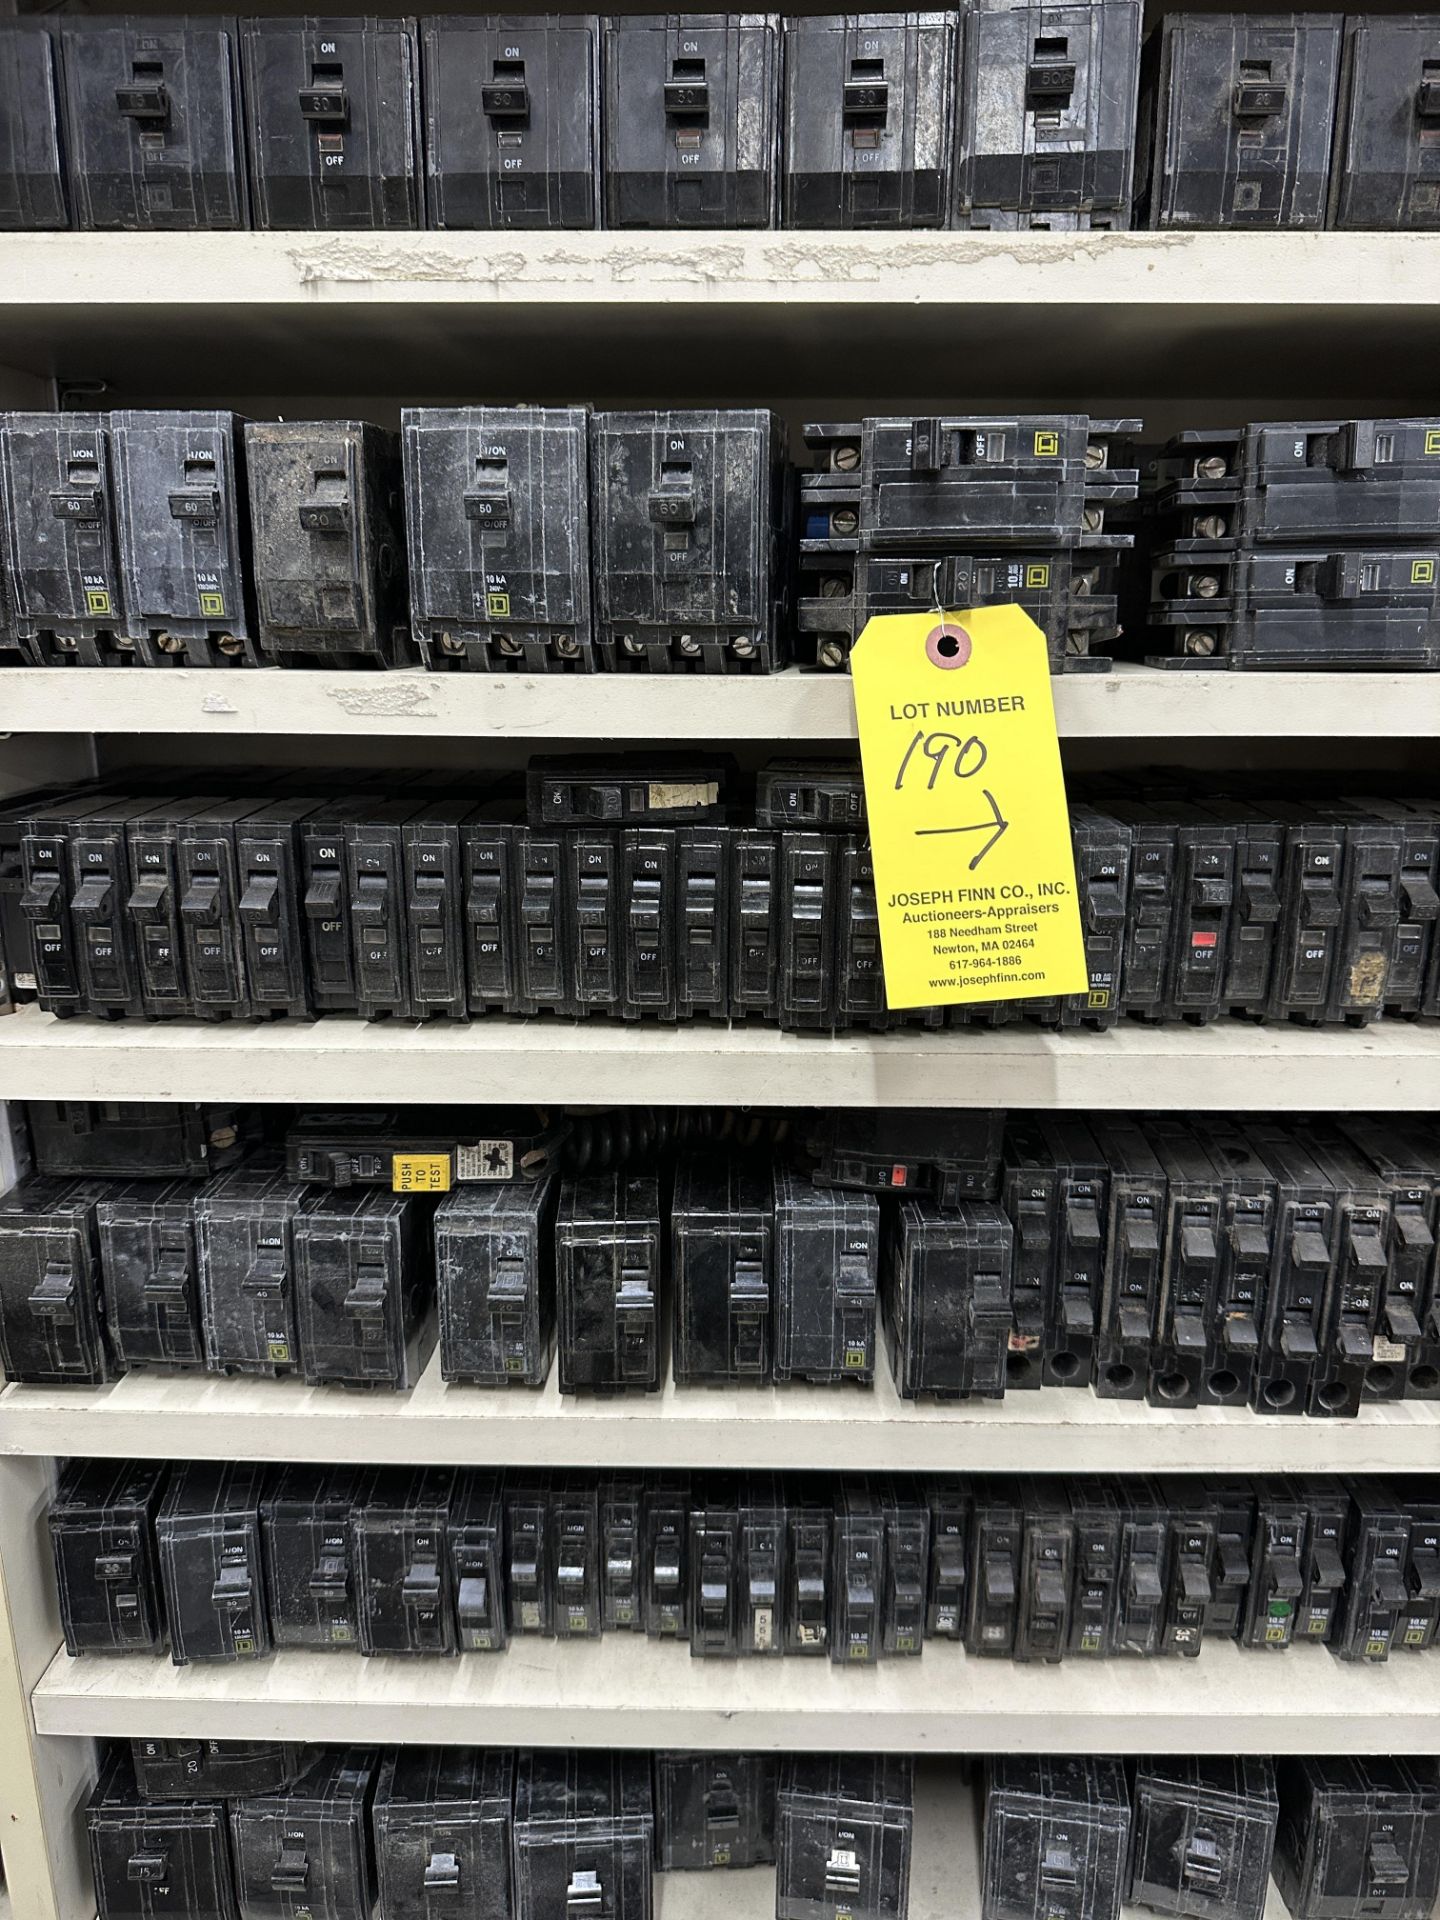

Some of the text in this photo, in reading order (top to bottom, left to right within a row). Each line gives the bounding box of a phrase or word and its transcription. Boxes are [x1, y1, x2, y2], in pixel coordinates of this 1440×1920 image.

[321, 42, 335, 53] ON
[684, 42, 697, 51] ON
[865, 41, 878, 50] ON
[505, 48, 519, 57] ON
[494, 93, 512, 105] 30
[326, 156, 344, 165] OFF
[682, 155, 699, 164] OFF
[862, 153, 879, 162] OFF
[505, 159, 522, 168] OFF
[671, 441, 684, 450] ON
[906, 439, 912, 455] ON
[976, 435, 985, 455] OFF
[1294, 441, 1303, 458] ON
[73, 450, 93, 458] I/ON
[191, 451, 212, 459] I/ON
[485, 447, 506, 455] I/ON
[67, 501, 80, 510] 60
[185, 502, 197, 512] 60
[479, 504, 492, 513] 50
[660, 504, 678, 515] 60
[670, 552, 687, 561] OFF
[84, 576, 104, 584] 10 kA
[207, 573, 217, 581] kA
[486, 575, 507, 583] 10 kA
[900, 572, 908, 584] ON
[1285, 569, 1294, 584] ON
[890, 696, 1025, 719] LOT NUMBER
[895, 731, 987, 789] 190
[790, 793, 797, 807] ON
[850, 793, 858, 811] OFF
[39, 850, 52, 858] ON
[89, 854, 102, 862] ON
[320, 849, 335, 858] ON
[1315, 856, 1329, 865] ON
[1102, 866, 1115, 874] ON
[888, 882, 1070, 907] JOSEPH FINN CO., INC.
[903, 903, 1059, 924] Auctioneers-Appraisers
[322, 922, 342, 931] OFF
[928, 922, 1038, 938] 188 Needham Street
[45, 944, 61, 952] OFF
[204, 947, 220, 955] OFF
[933, 939, 1035, 955] Newton, MA 02464
[1403, 945, 1419, 953] OFF
[641, 953, 657, 961] OFF
[1195, 951, 1213, 959] OFF
[1306, 950, 1325, 958] OFF
[856, 960, 873, 968] OFF
[949, 956, 1022, 969] 617-964-1886
[929, 970, 1045, 988] www.josephfinn.com
[299, 1157, 308, 1170] ON
[402, 1163, 410, 1189] PUSH
[417, 1170, 426, 1182] TO
[431, 1164, 440, 1189] TEST
[878, 1172, 886, 1185] OFF
[1248, 1201, 1260, 1209] ON
[1400, 1281, 1413, 1290] ON
[1356, 1299, 1368, 1307] ON
[1280, 1536, 1292, 1544] ON
[149, 1744, 155, 1754] ON
[210, 1740, 219, 1754] OFF
[188, 1760, 197, 1773] 20
[139, 1867, 149, 1876] 15
